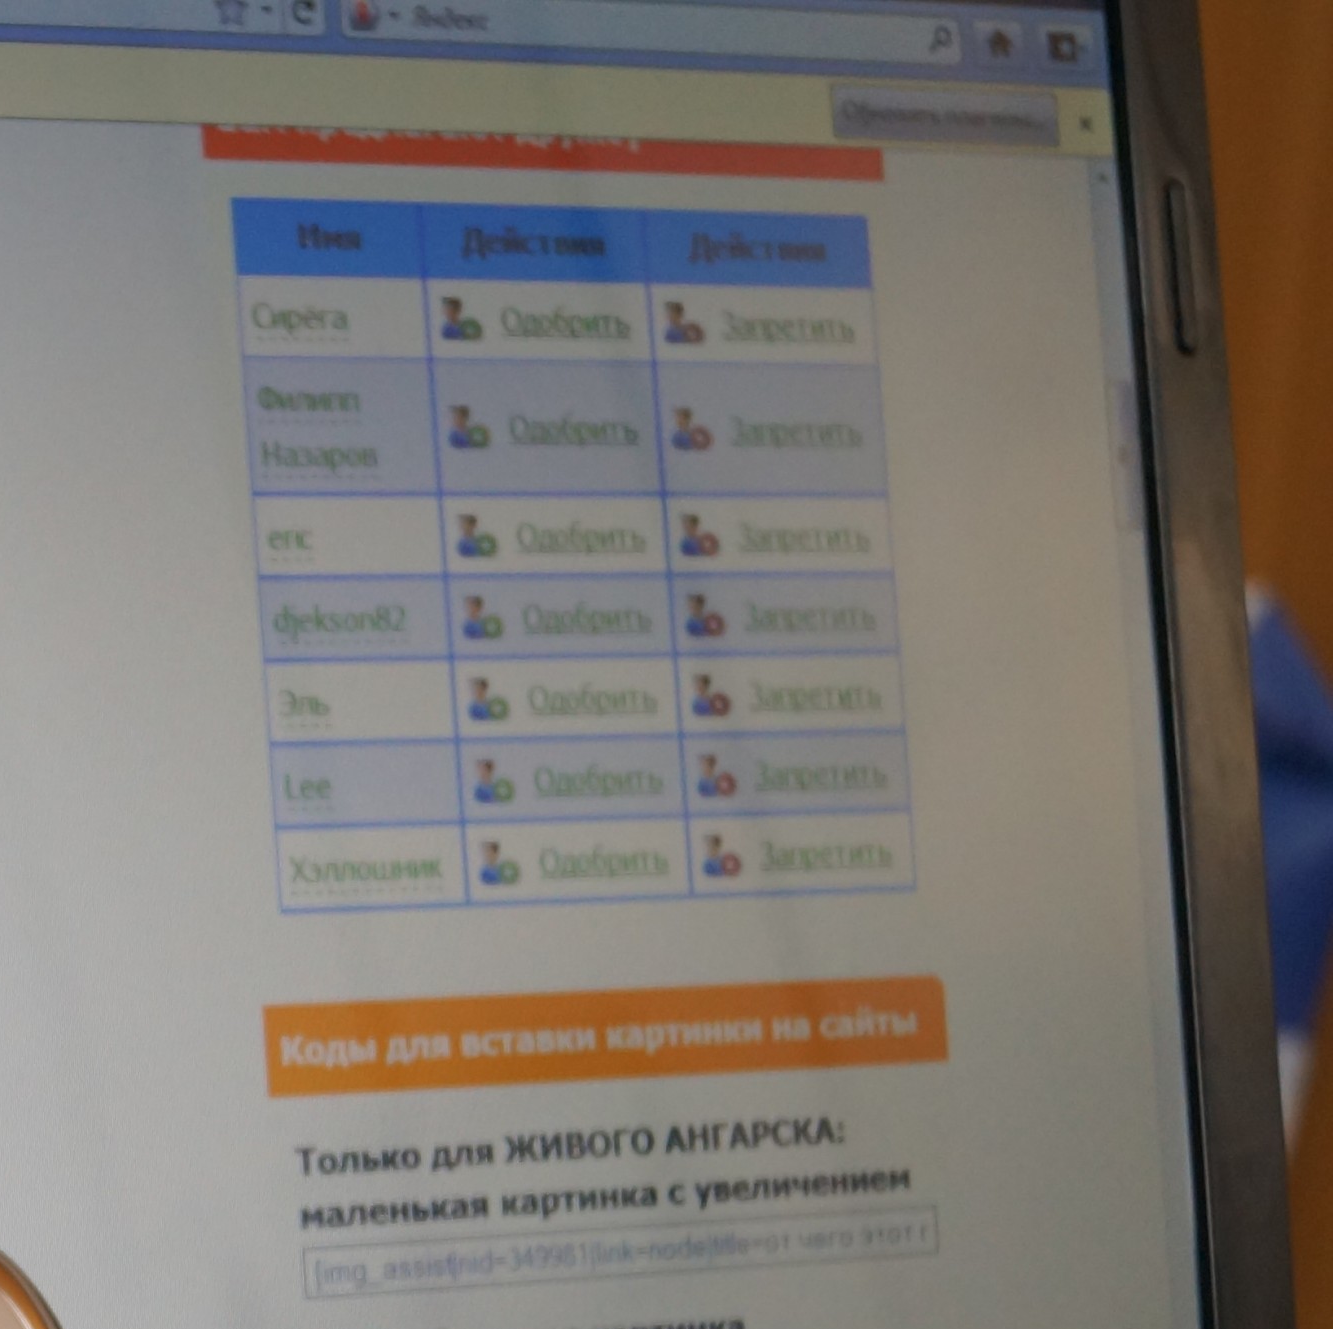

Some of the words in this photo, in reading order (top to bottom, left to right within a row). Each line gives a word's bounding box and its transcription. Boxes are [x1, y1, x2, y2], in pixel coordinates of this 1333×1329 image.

[297, 222, 363, 253] Имя
[461, 226, 607, 260] Действия
[688, 231, 827, 265] Действия
[500, 306, 631, 341] Одобрить
[509, 414, 639, 449] Одобрить
[516, 523, 647, 557] Одобрить
[523, 603, 653, 638] Одобрить
[283, 773, 333, 802] Lee
[533, 763, 665, 798] Одобрить
[539, 844, 670, 880] Одобрить
[280, 1032, 377, 1068] Коды
[386, 1031, 449, 1063] для
[461, 1023, 597, 1059] вставки
[606, 1014, 763, 1056] картинки
[772, 1013, 810, 1042] на
[819, 1005, 920, 1040] сайты
[296, 1146, 422, 1177] Только
[432, 1140, 495, 1173] для
[504, 1128, 656, 1165] ЖИВОГО
[664, 1115, 846, 1156] АНГАРСКА:
[300, 1193, 491, 1230] маленькая
[501, 1183, 659, 1222] картинка
[668, 1184, 689, 1208] с
[695, 1166, 913, 1210] увеличением
